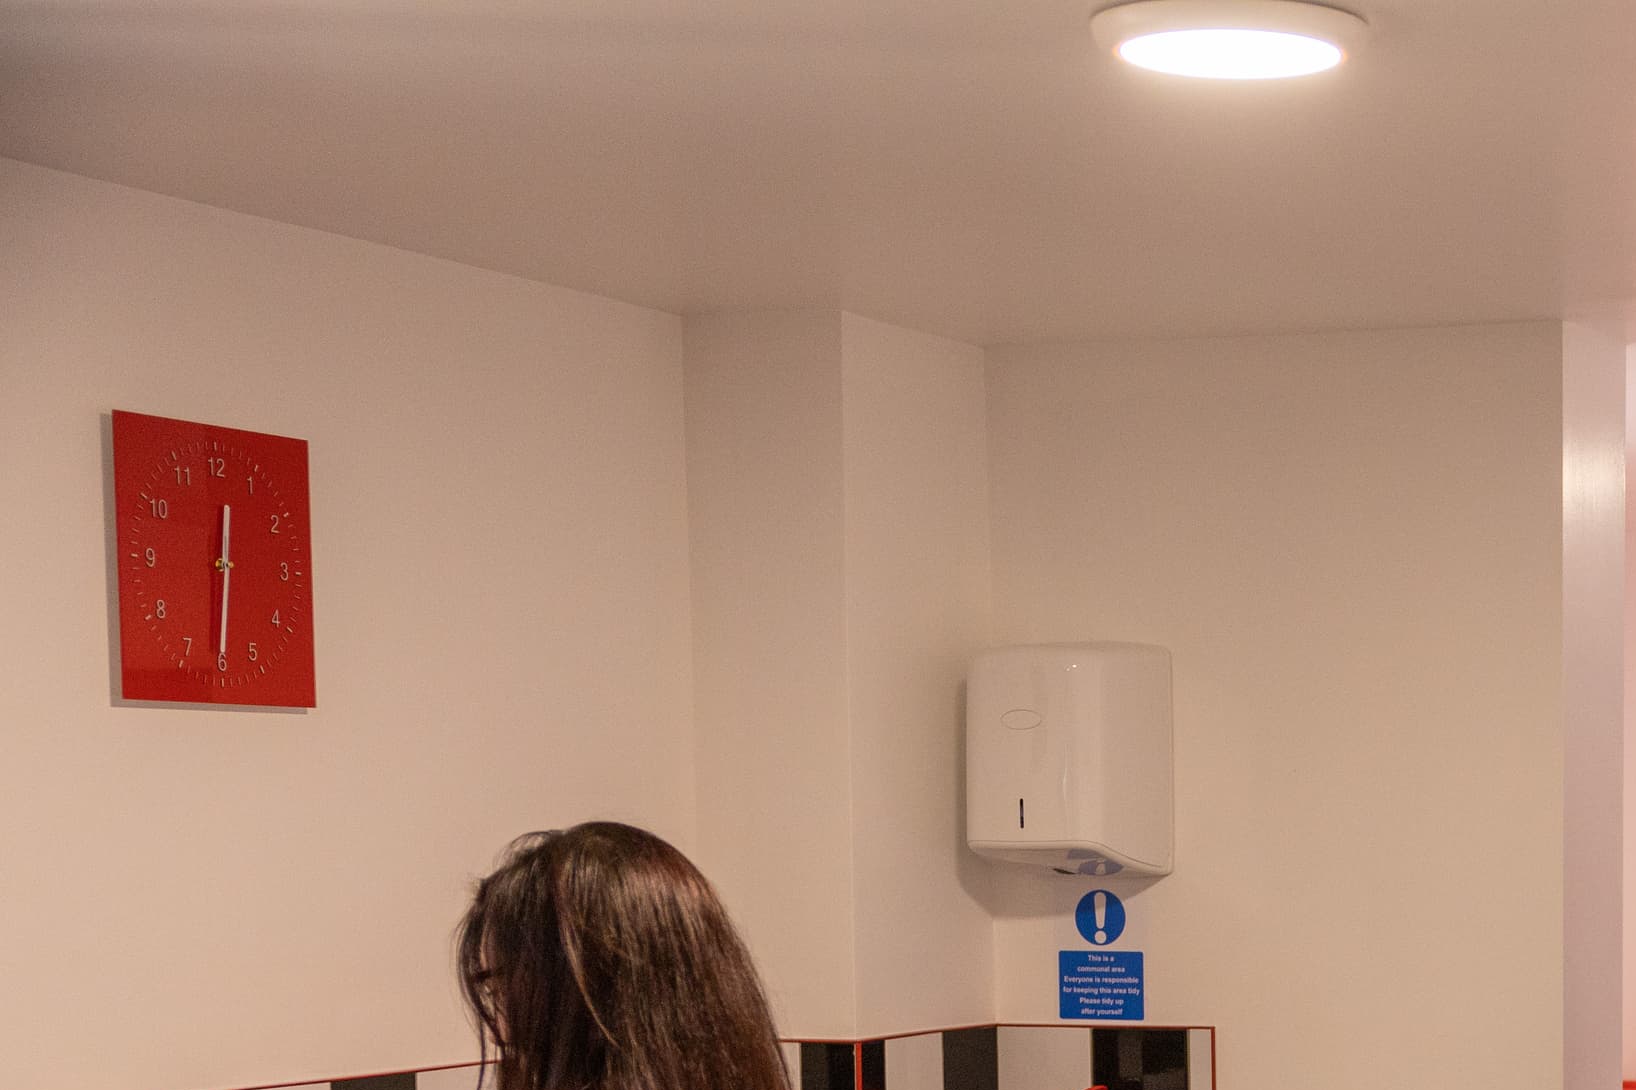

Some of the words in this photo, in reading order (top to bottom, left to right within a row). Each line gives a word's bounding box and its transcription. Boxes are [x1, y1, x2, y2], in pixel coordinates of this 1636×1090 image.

[174, 466, 191, 486] 11
[208, 457, 226, 478] 12
[150, 498, 168, 519] 10
[270, 514, 280, 534] 2
[145, 547, 156, 568] 9
[280, 562, 289, 582] 3
[156, 599, 166, 619] 8
[271, 609, 281, 628] 4
[183, 637, 193, 657] 7
[248, 642, 257, 661] 5
[217, 652, 228, 672] 6
[1088, 954, 1101, 962] This
[1063, 975, 1093, 984] Everyone
[1102, 976, 1139, 985] responsible
[1074, 987, 1098, 995] keeping
[1128, 988, 1140, 996] tidy
[1097, 1008, 1123, 1016] yourself
[1102, 998, 1114, 1006] tidy
